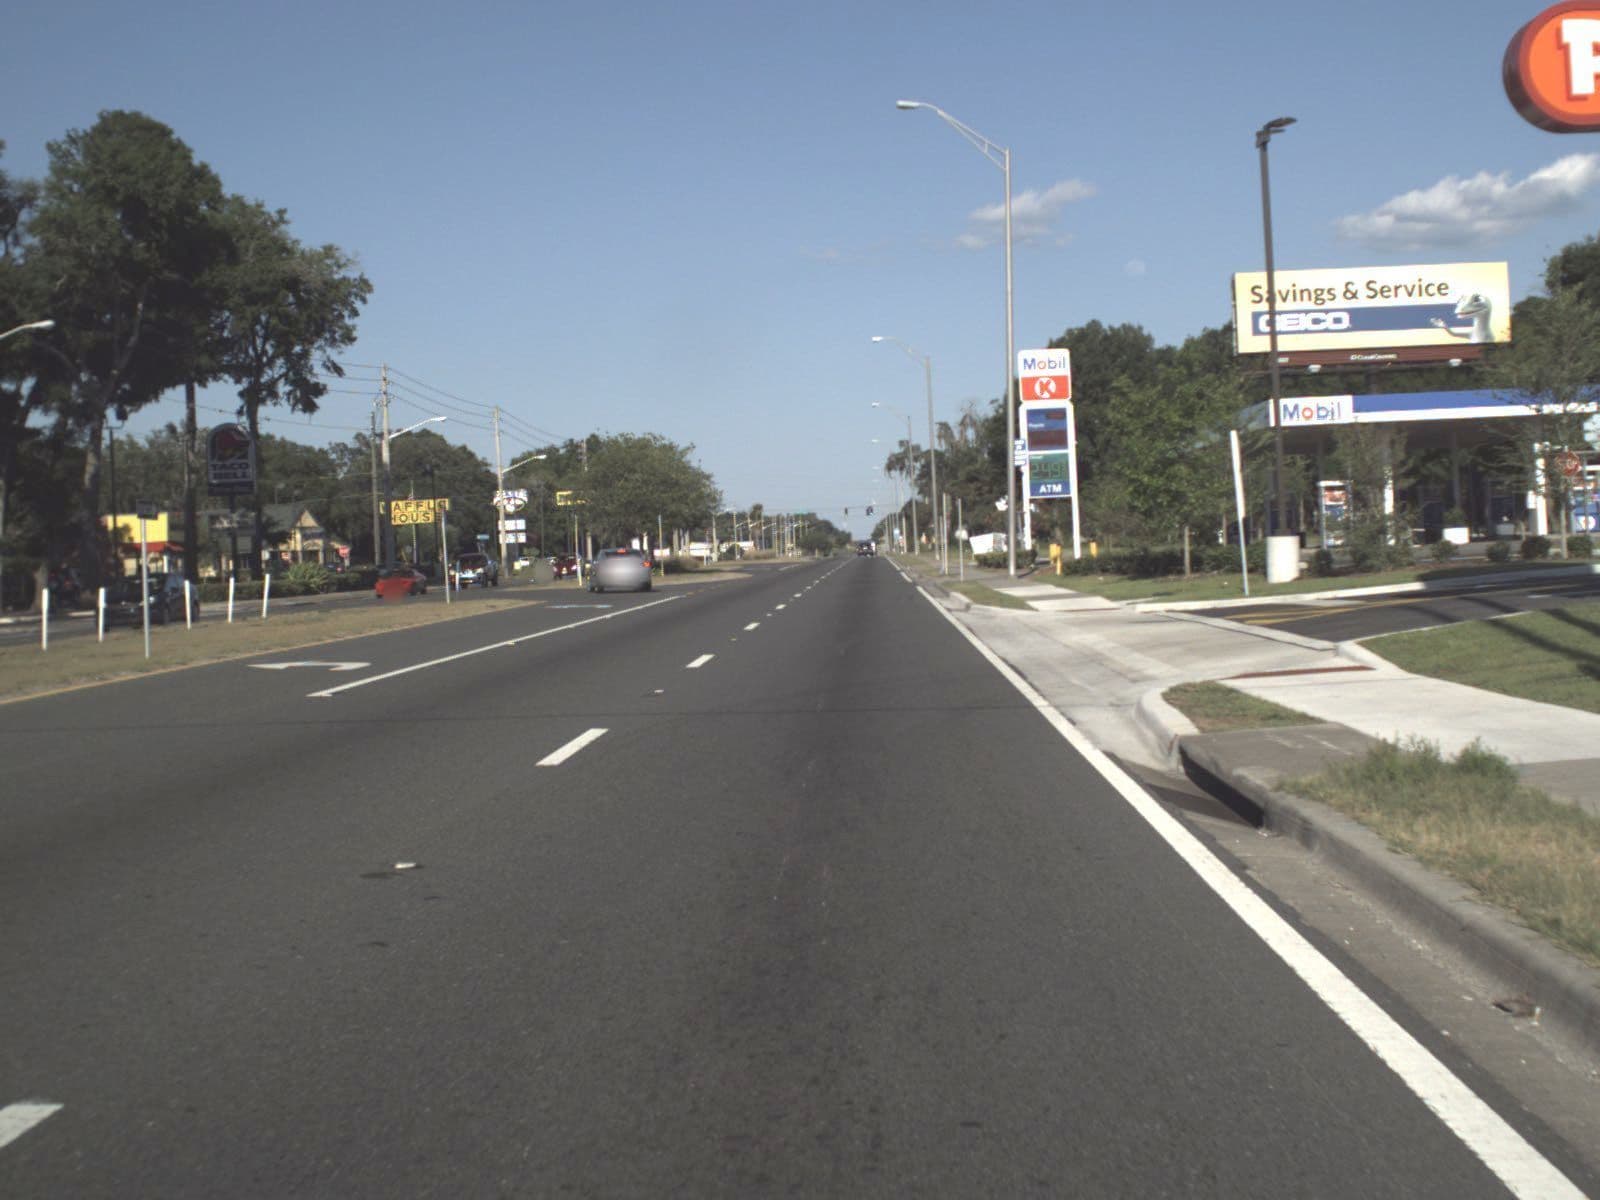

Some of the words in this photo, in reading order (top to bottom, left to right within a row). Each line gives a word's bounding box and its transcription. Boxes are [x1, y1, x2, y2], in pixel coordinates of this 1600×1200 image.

[1342, 281, 1359, 300] &
[1366, 277, 1450, 299] Service
[1023, 356, 1066, 370] Mobil
[1282, 401, 1341, 422] Mobil
[1039, 483, 1062, 494] ATM
